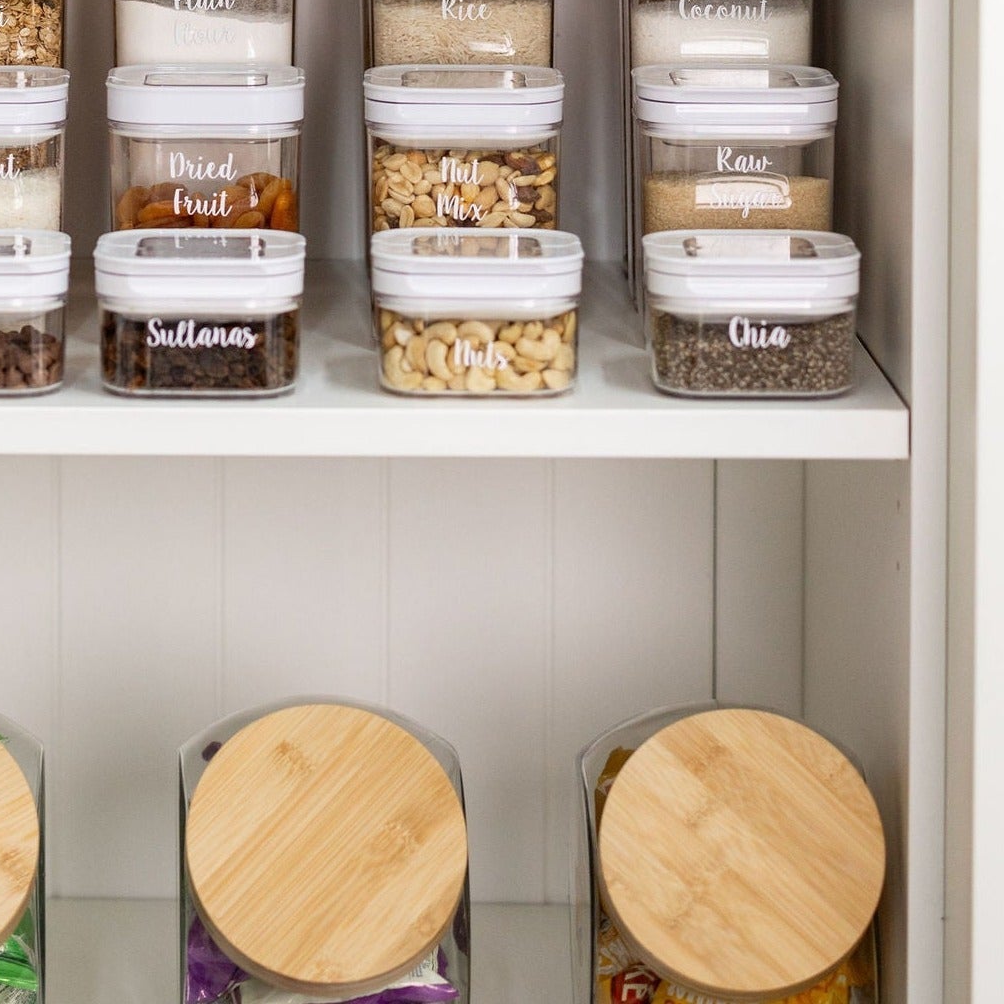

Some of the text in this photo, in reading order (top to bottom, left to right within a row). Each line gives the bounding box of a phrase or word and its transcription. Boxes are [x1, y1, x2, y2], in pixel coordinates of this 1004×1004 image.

[169, 151, 237, 182] Dried
[440, 156, 484, 186] Nut
[716, 145, 773, 172] Raw
[172, 189, 233, 218] Fruit
[436, 194, 487, 223] Mix
[146, 316, 259, 349] Sultanas
[729, 315, 792, 350] Chia
[453, 337, 510, 370] Nuts
